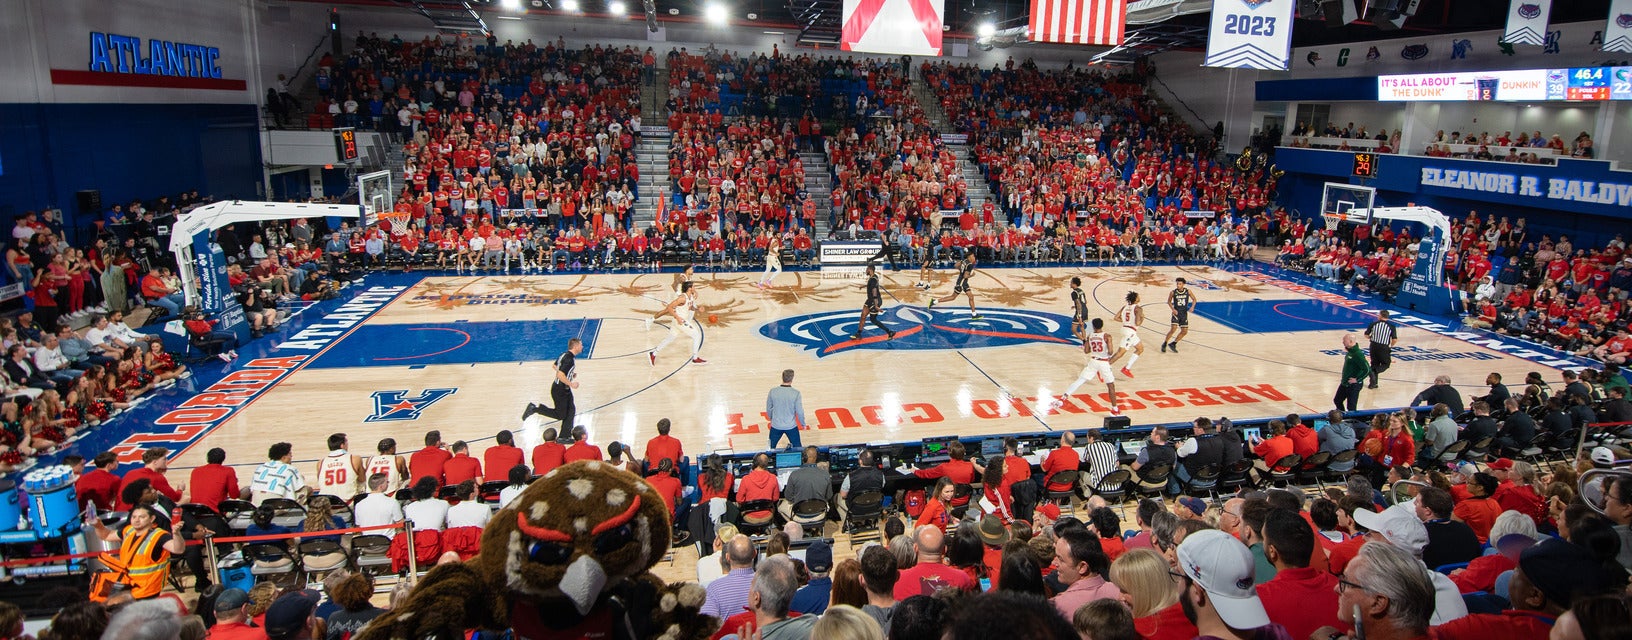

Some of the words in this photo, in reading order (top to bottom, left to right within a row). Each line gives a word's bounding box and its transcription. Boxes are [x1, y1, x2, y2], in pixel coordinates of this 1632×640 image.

[1224, 14, 1276, 36] 2023
[89, 31, 222, 79] ATLANTIC
[1575, 69, 1603, 80] 46.4
[1382, 79, 1398, 87] IT'S
[1400, 78, 1419, 87] ALL
[1421, 76, 1457, 87] ABOUT
[1502, 81, 1541, 89] DUNKIN'
[1614, 82, 1631, 93] 22
[1392, 88, 1411, 97] THE
[1549, 84, 1563, 94] 39
[1356, 162, 1370, 175] 29
[1421, 167, 1515, 194] ELEANOR
[1519, 176, 1543, 197] R.
[202, 268, 210, 282] Blue
[204, 283, 212, 310] Florida
[1177, 298, 1186, 307] 24
[1125, 312, 1130, 322] 5
[1091, 341, 1103, 353] 23
[86, 355, 310, 465] FLORIDA
[275, 285, 408, 350] ATLANTIC
[970, 383, 1293, 420] ABESSINIO
[724, 402, 945, 436] COUT
[325, 468, 347, 486] 50
[371, 466, 390, 480] 15
